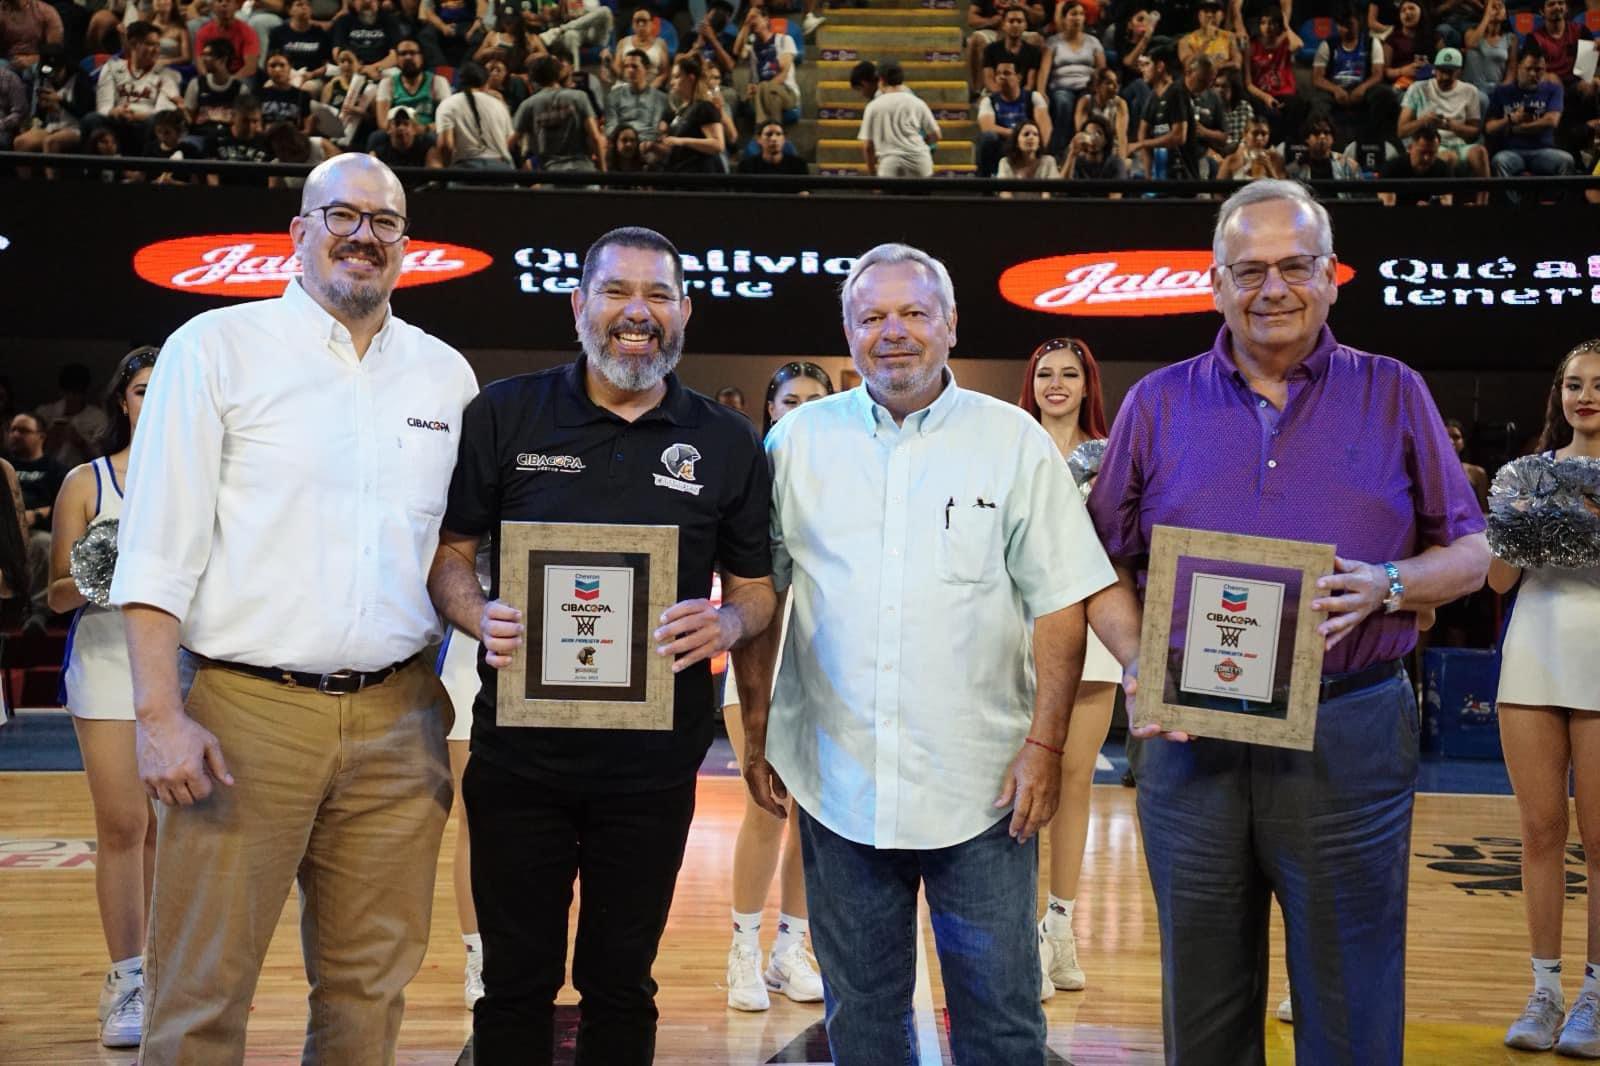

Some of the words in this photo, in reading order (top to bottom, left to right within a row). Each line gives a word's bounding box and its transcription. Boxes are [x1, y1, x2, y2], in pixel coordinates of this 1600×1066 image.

[1378, 256, 1517, 284] Qué
[407, 417, 450, 433] CIBACOPA
[516, 452, 585, 469] CIBACOPA
[560, 603, 612, 613] CIBACOPA
[1206, 612, 1259, 627] CIBACOPA
